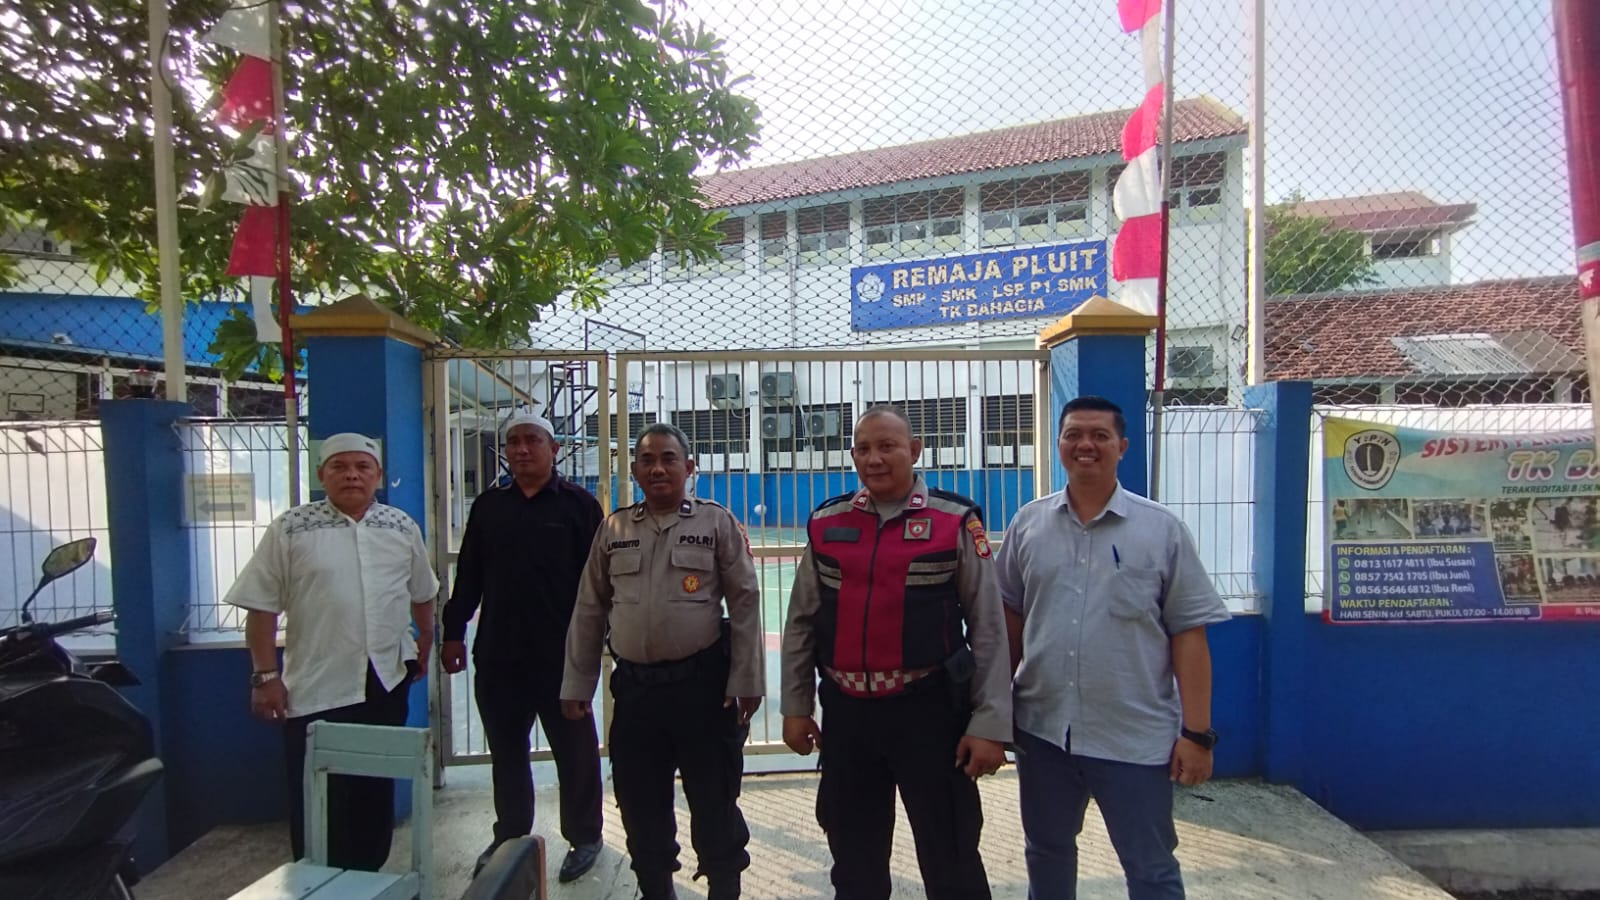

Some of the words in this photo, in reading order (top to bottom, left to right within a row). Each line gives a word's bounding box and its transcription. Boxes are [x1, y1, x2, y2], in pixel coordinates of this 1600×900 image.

[893, 259, 1002, 288] REMAJA
[1013, 249, 1098, 277] PLUIT
[893, 292, 926, 307] SMP
[941, 288, 977, 302] SMK
[993, 283, 1025, 298] LSP
[1031, 280, 1050, 294] P1
[1058, 275, 1098, 292] SMK
[939, 305, 962, 318] TK
[967, 298, 1047, 317] BAHAGIA
[1508, 450, 1560, 481] TK
[1502, 485, 1570, 494] TERAKREDITASI
[679, 535, 714, 546] POLRI
[1337, 546, 1390, 556] INFORMASI
[1354, 559, 1381, 569] 0813
[1445, 557, 1475, 567] Susan)
[1354, 572, 1381, 581] 0857
[1340, 599, 1376, 609] WAKTU
[1340, 610, 1360, 619] HARI
[1362, 610, 1389, 618] SENIN
